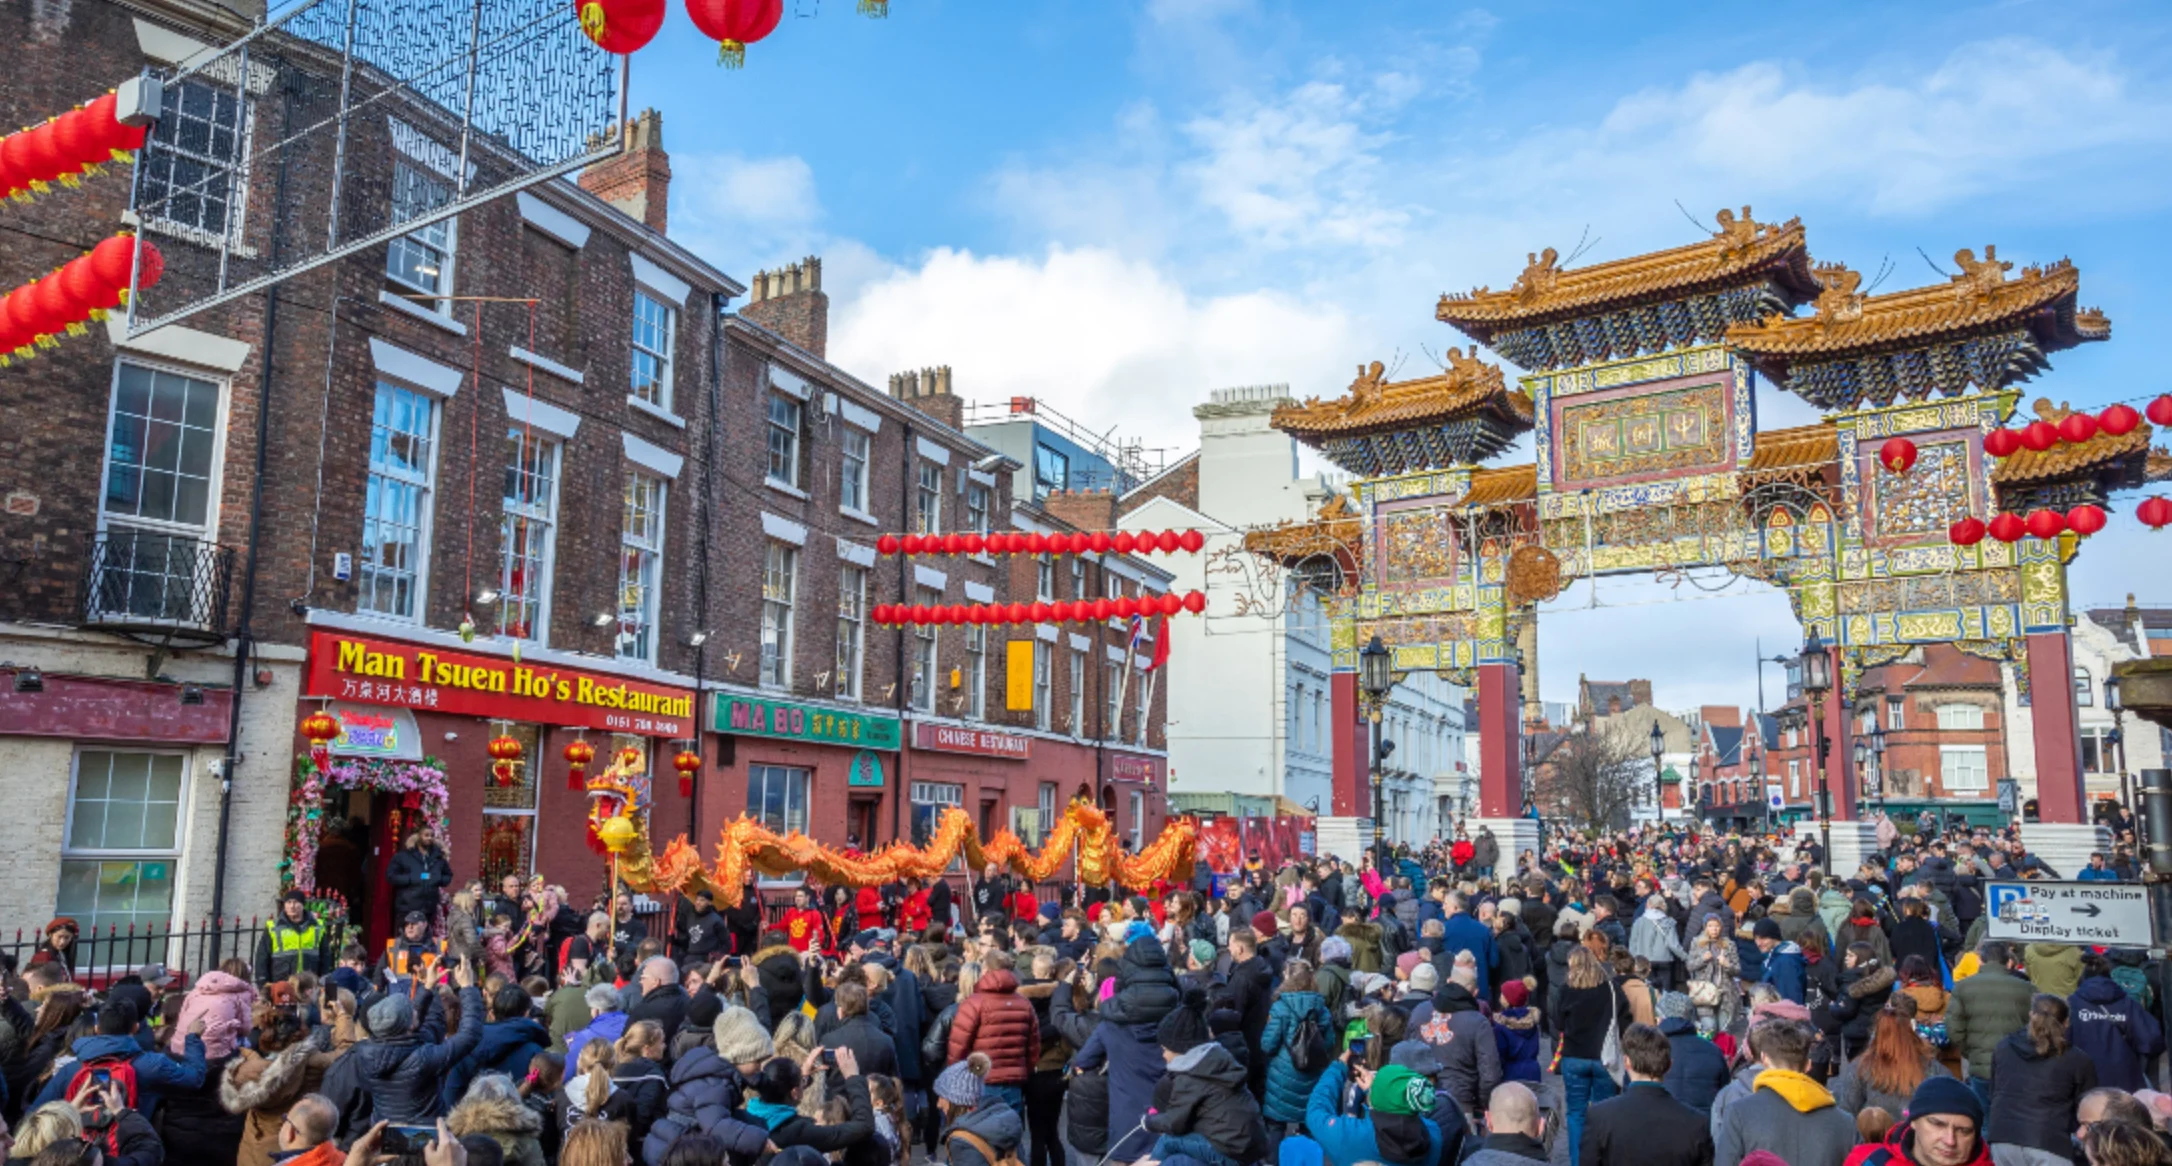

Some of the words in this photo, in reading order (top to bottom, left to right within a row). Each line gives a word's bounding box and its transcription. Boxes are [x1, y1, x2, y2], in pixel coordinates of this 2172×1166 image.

[337, 640, 405, 680] Man
[416, 652, 506, 692] Tsuen
[512, 666, 571, 701] Ho's
[577, 676, 692, 718] Restaurant
[731, 700, 766, 733] MA
[773, 707, 804, 734] BO
[938, 728, 976, 748] CHINESE
[980, 734, 1029, 753] RESTAURANT
[2030, 886, 2056, 900] Pay
[2061, 888, 2076, 898] at
[2080, 888, 2142, 900] machine
[2020, 923, 2072, 938] Display
[2076, 926, 2120, 938] ticket
